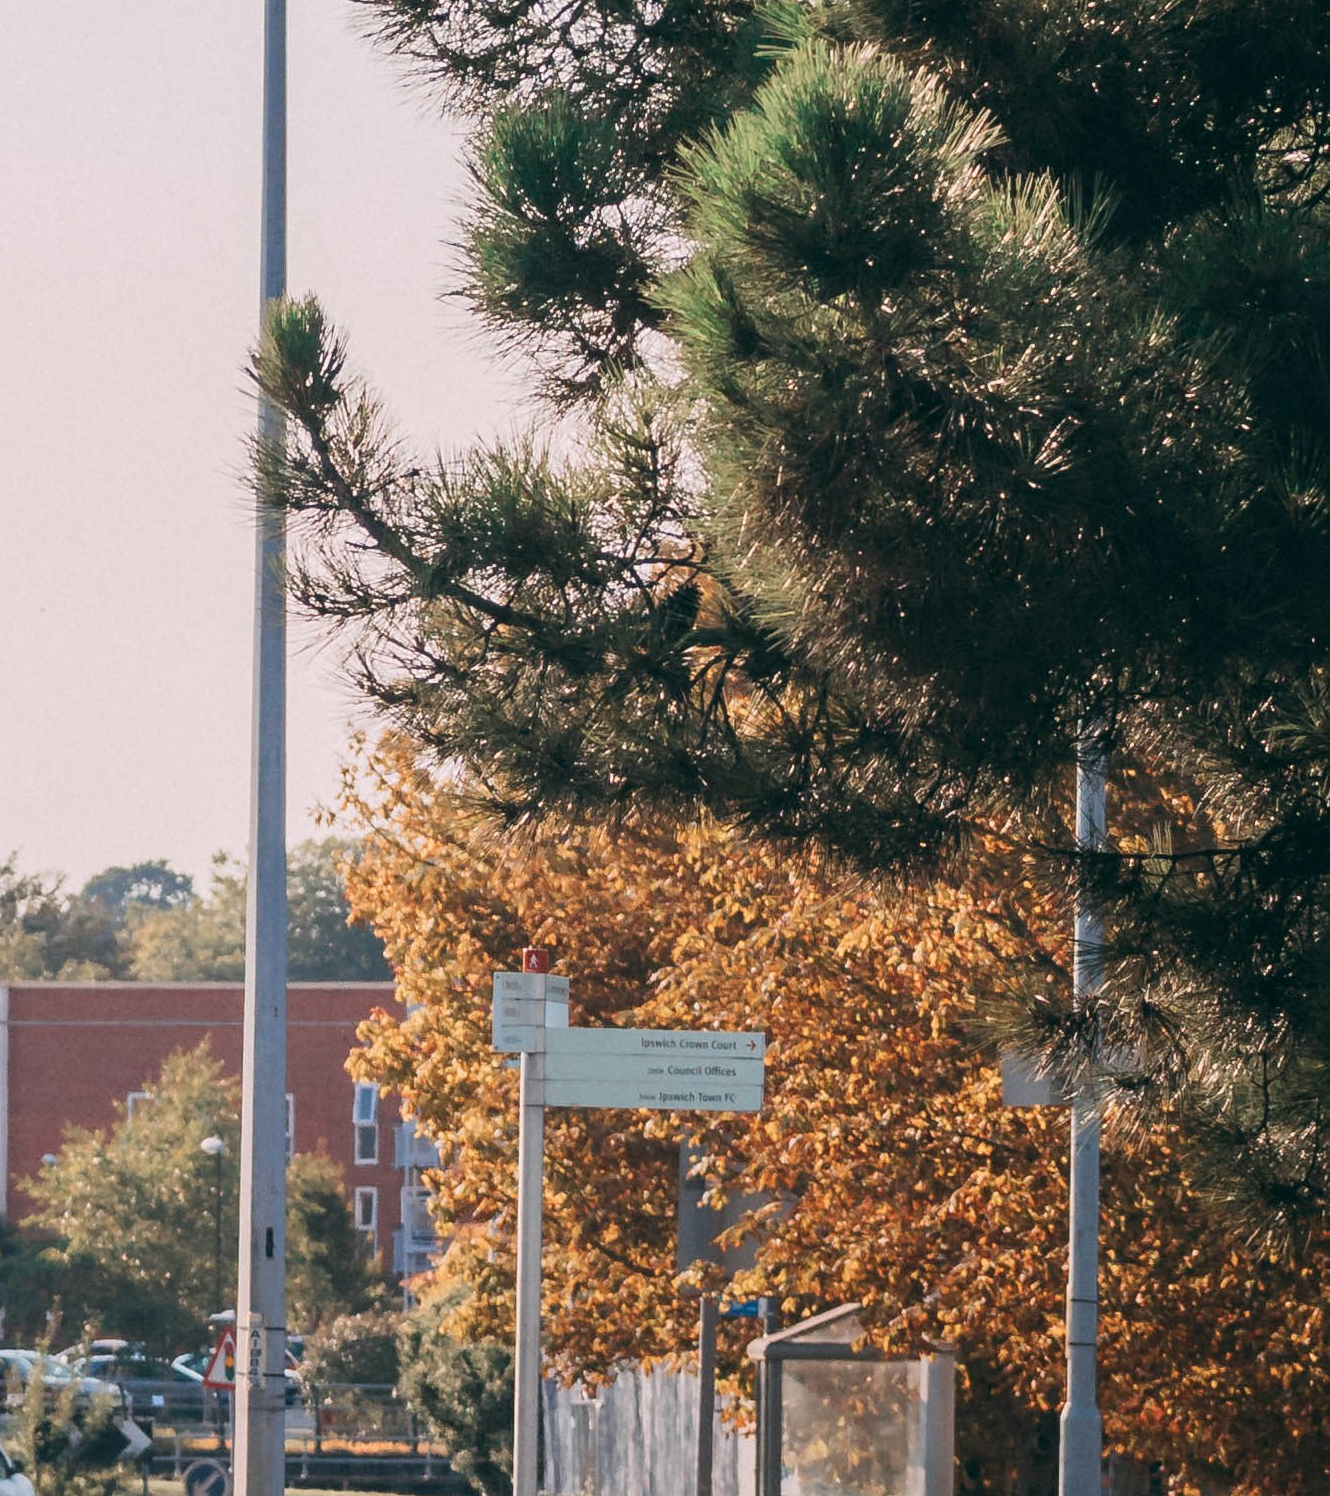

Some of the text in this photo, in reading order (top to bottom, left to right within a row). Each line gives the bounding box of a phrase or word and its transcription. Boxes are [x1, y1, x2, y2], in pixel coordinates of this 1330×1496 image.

[641, 1037, 737, 1050] Ipswich Crown Court
[667, 1064, 702, 1076] Council
[704, 1066, 737, 1076] Offices
[659, 1091, 695, 1103] Ipswich
[698, 1092, 722, 1102] Town
[724, 1092, 736, 1103] FC
